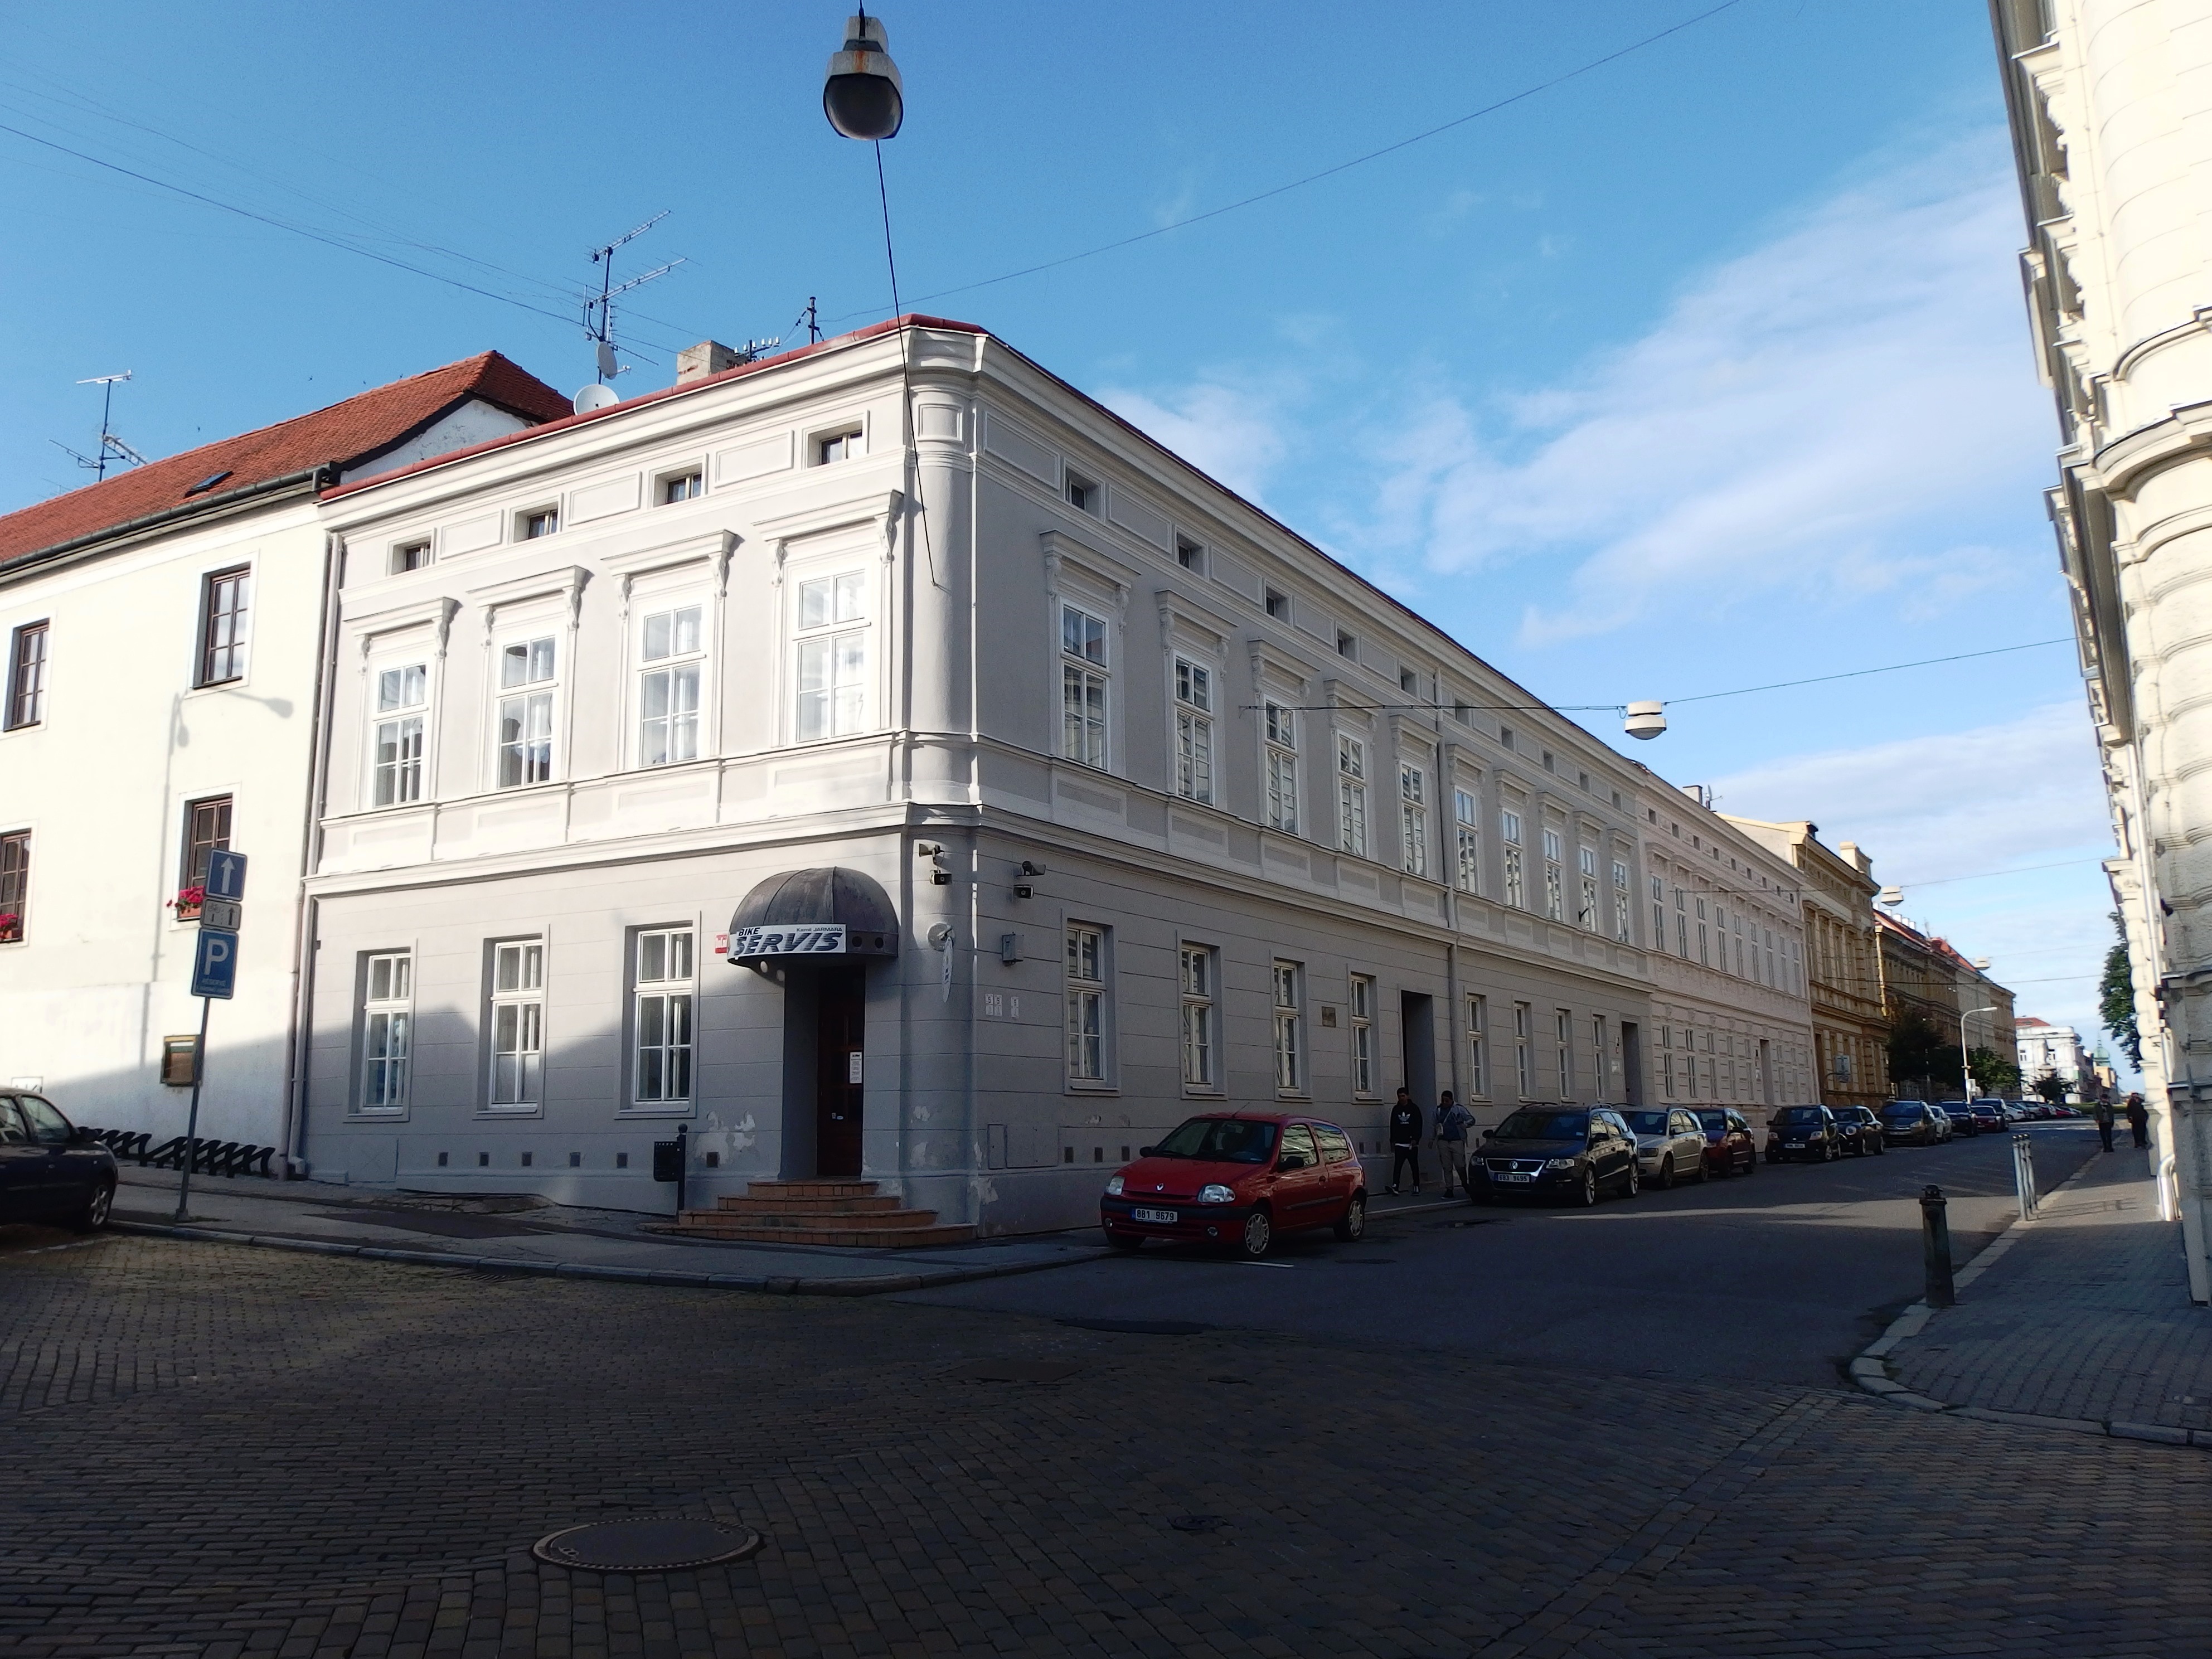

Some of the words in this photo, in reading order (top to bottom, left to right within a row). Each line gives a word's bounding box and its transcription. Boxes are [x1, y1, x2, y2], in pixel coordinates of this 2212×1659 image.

[739, 927, 760, 936] BIKE
[734, 933, 843, 956] SERVIS
[204, 938, 229, 975] P
[1137, 1209, 1150, 1219] 8B1
[1156, 1211, 1174, 1221] 9679
